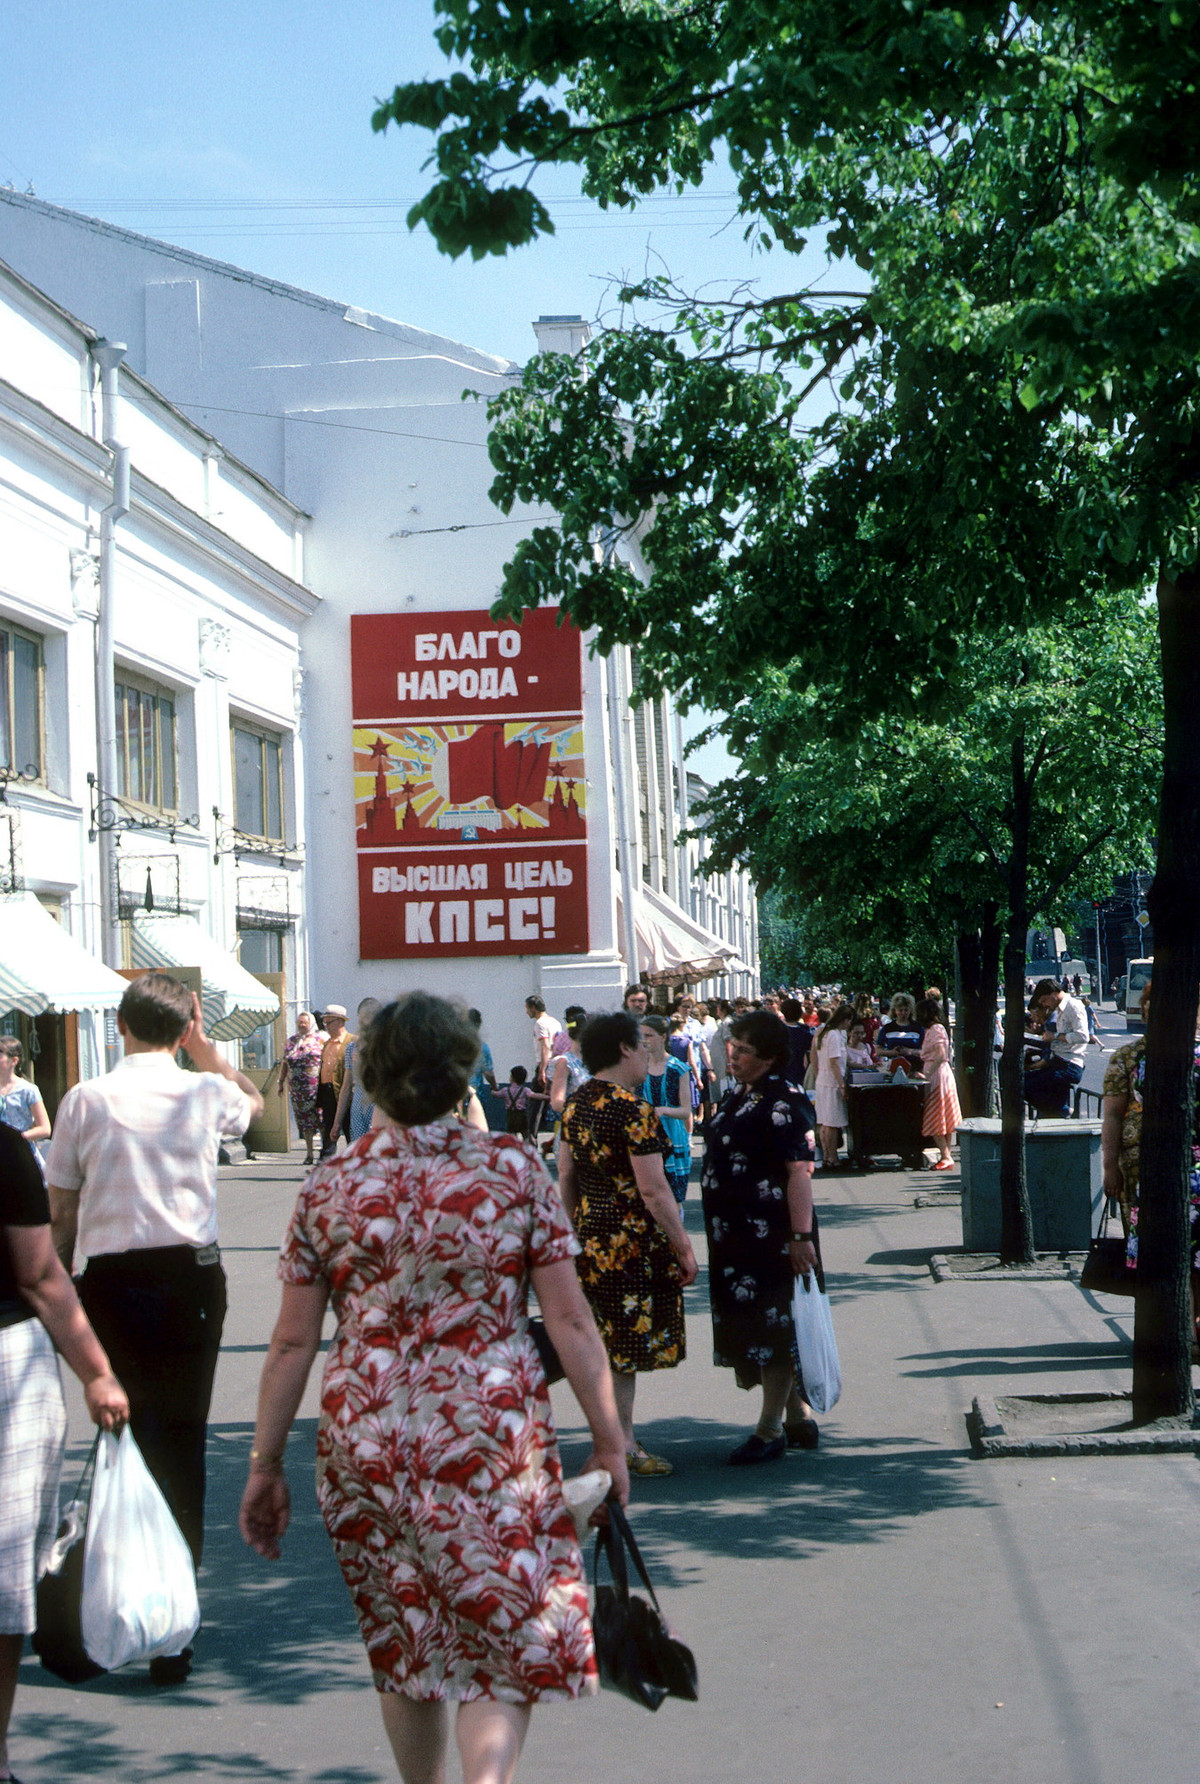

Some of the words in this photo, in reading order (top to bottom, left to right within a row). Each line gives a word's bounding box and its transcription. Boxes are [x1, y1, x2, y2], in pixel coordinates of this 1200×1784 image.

[414, 630, 522, 662] БЛАГО
[397, 667, 519, 701] НАРОДА
[372, 864, 488, 893] ВЫСШАЯ
[505, 860, 573, 891] ЦЕЛЬ
[405, 897, 556, 944] КПСС!
